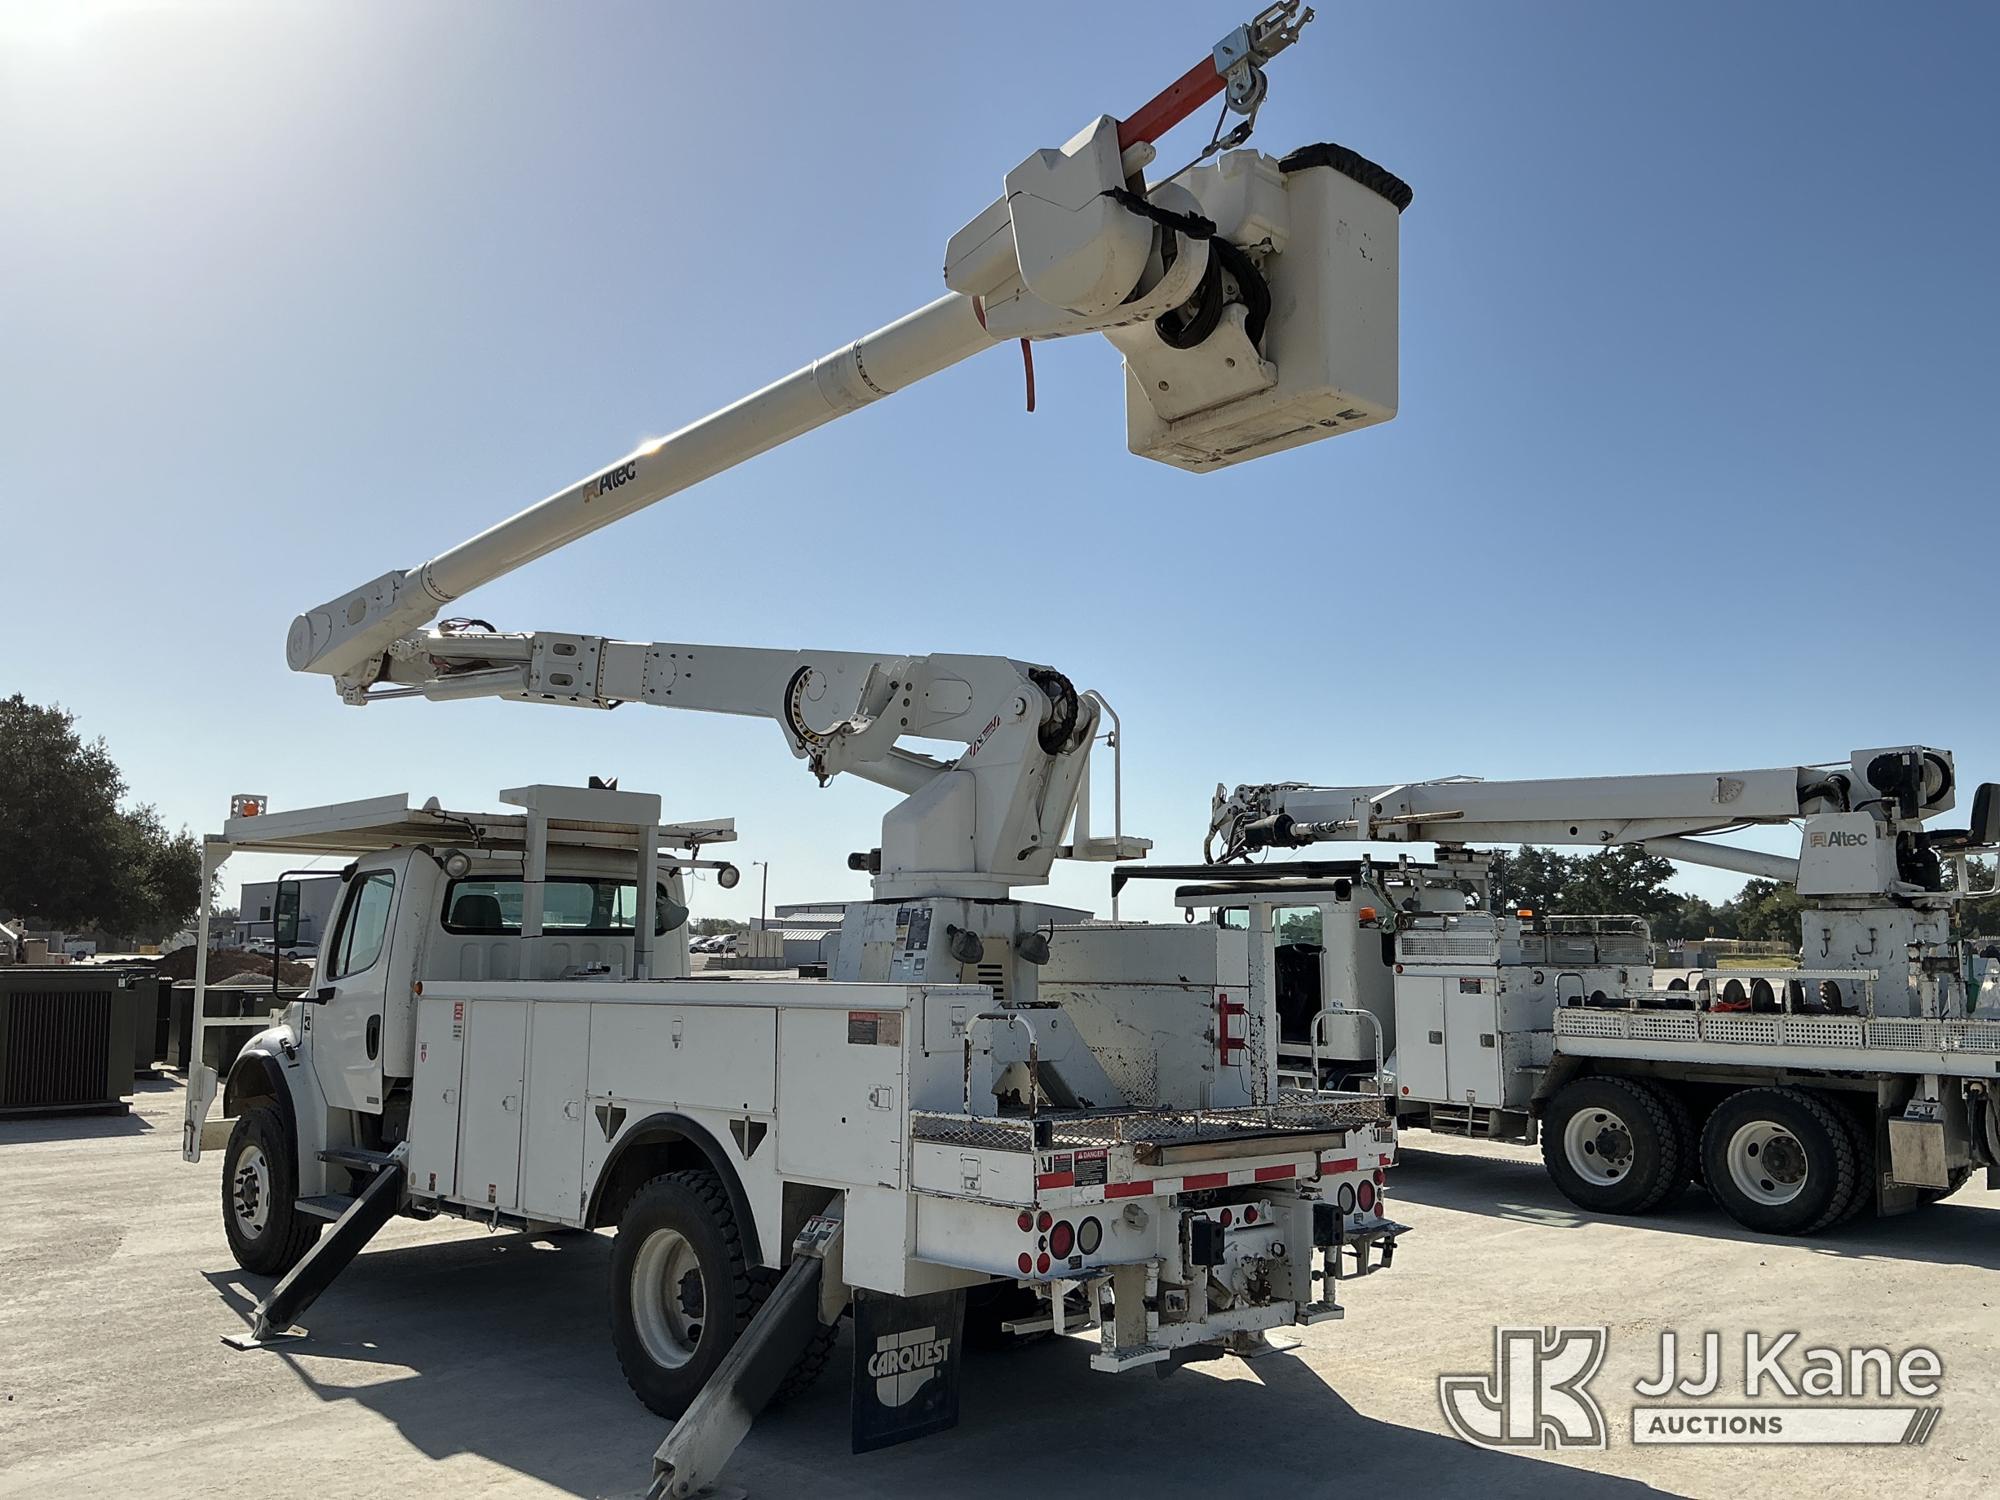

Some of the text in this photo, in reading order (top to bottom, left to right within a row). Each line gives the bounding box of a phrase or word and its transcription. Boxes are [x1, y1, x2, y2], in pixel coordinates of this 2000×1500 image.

[600, 460, 636, 495] Altec
[1828, 831, 1868, 847] Altec
[867, 1338, 951, 1378] CARQUEST
